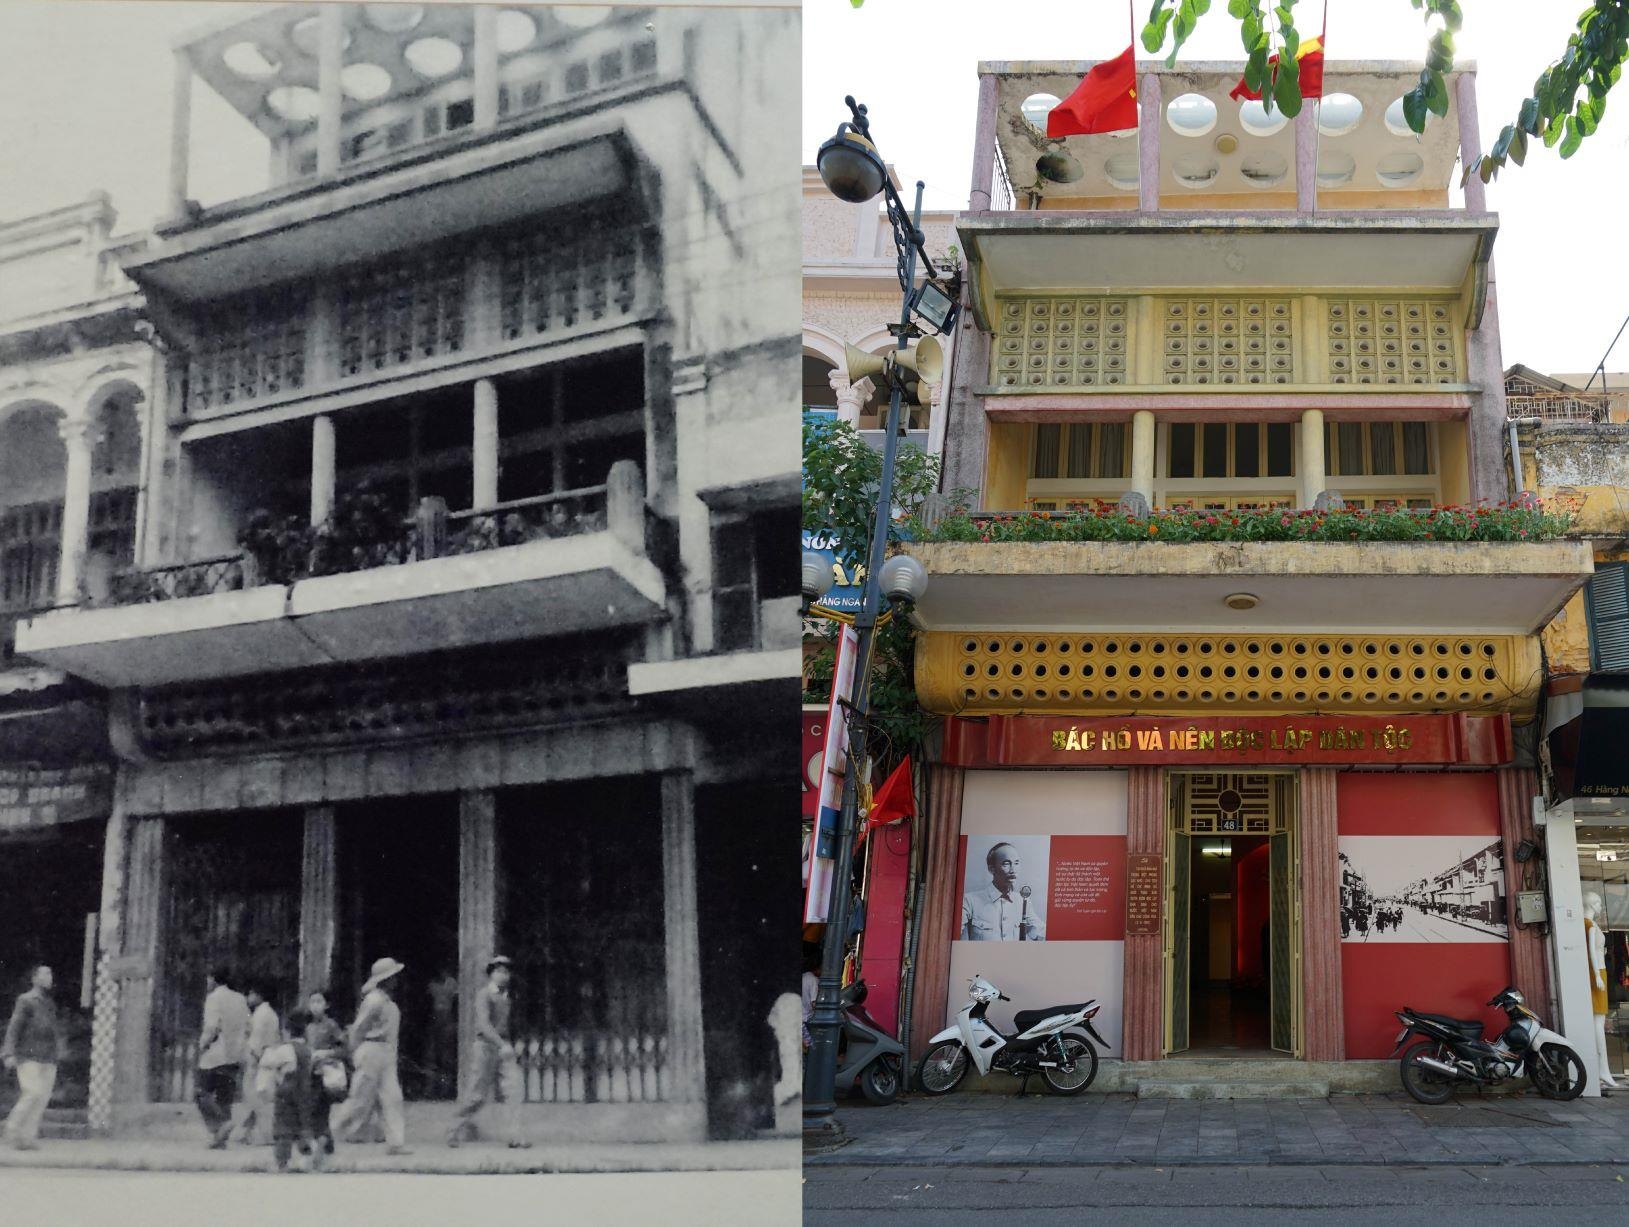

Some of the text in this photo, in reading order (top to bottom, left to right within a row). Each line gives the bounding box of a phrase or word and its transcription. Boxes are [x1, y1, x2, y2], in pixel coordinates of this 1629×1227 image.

[1052, 726, 1096, 751] BÁC
[1137, 726, 1163, 750] VÀ
[1270, 725, 1313, 754] LẬP
[1319, 725, 1365, 750] DÂN
[1372, 724, 1413, 754] TỘC
[1580, 785, 1593, 793] 46
[1595, 784, 1619, 795] Hàng
[1223, 821, 1235, 830] 48
